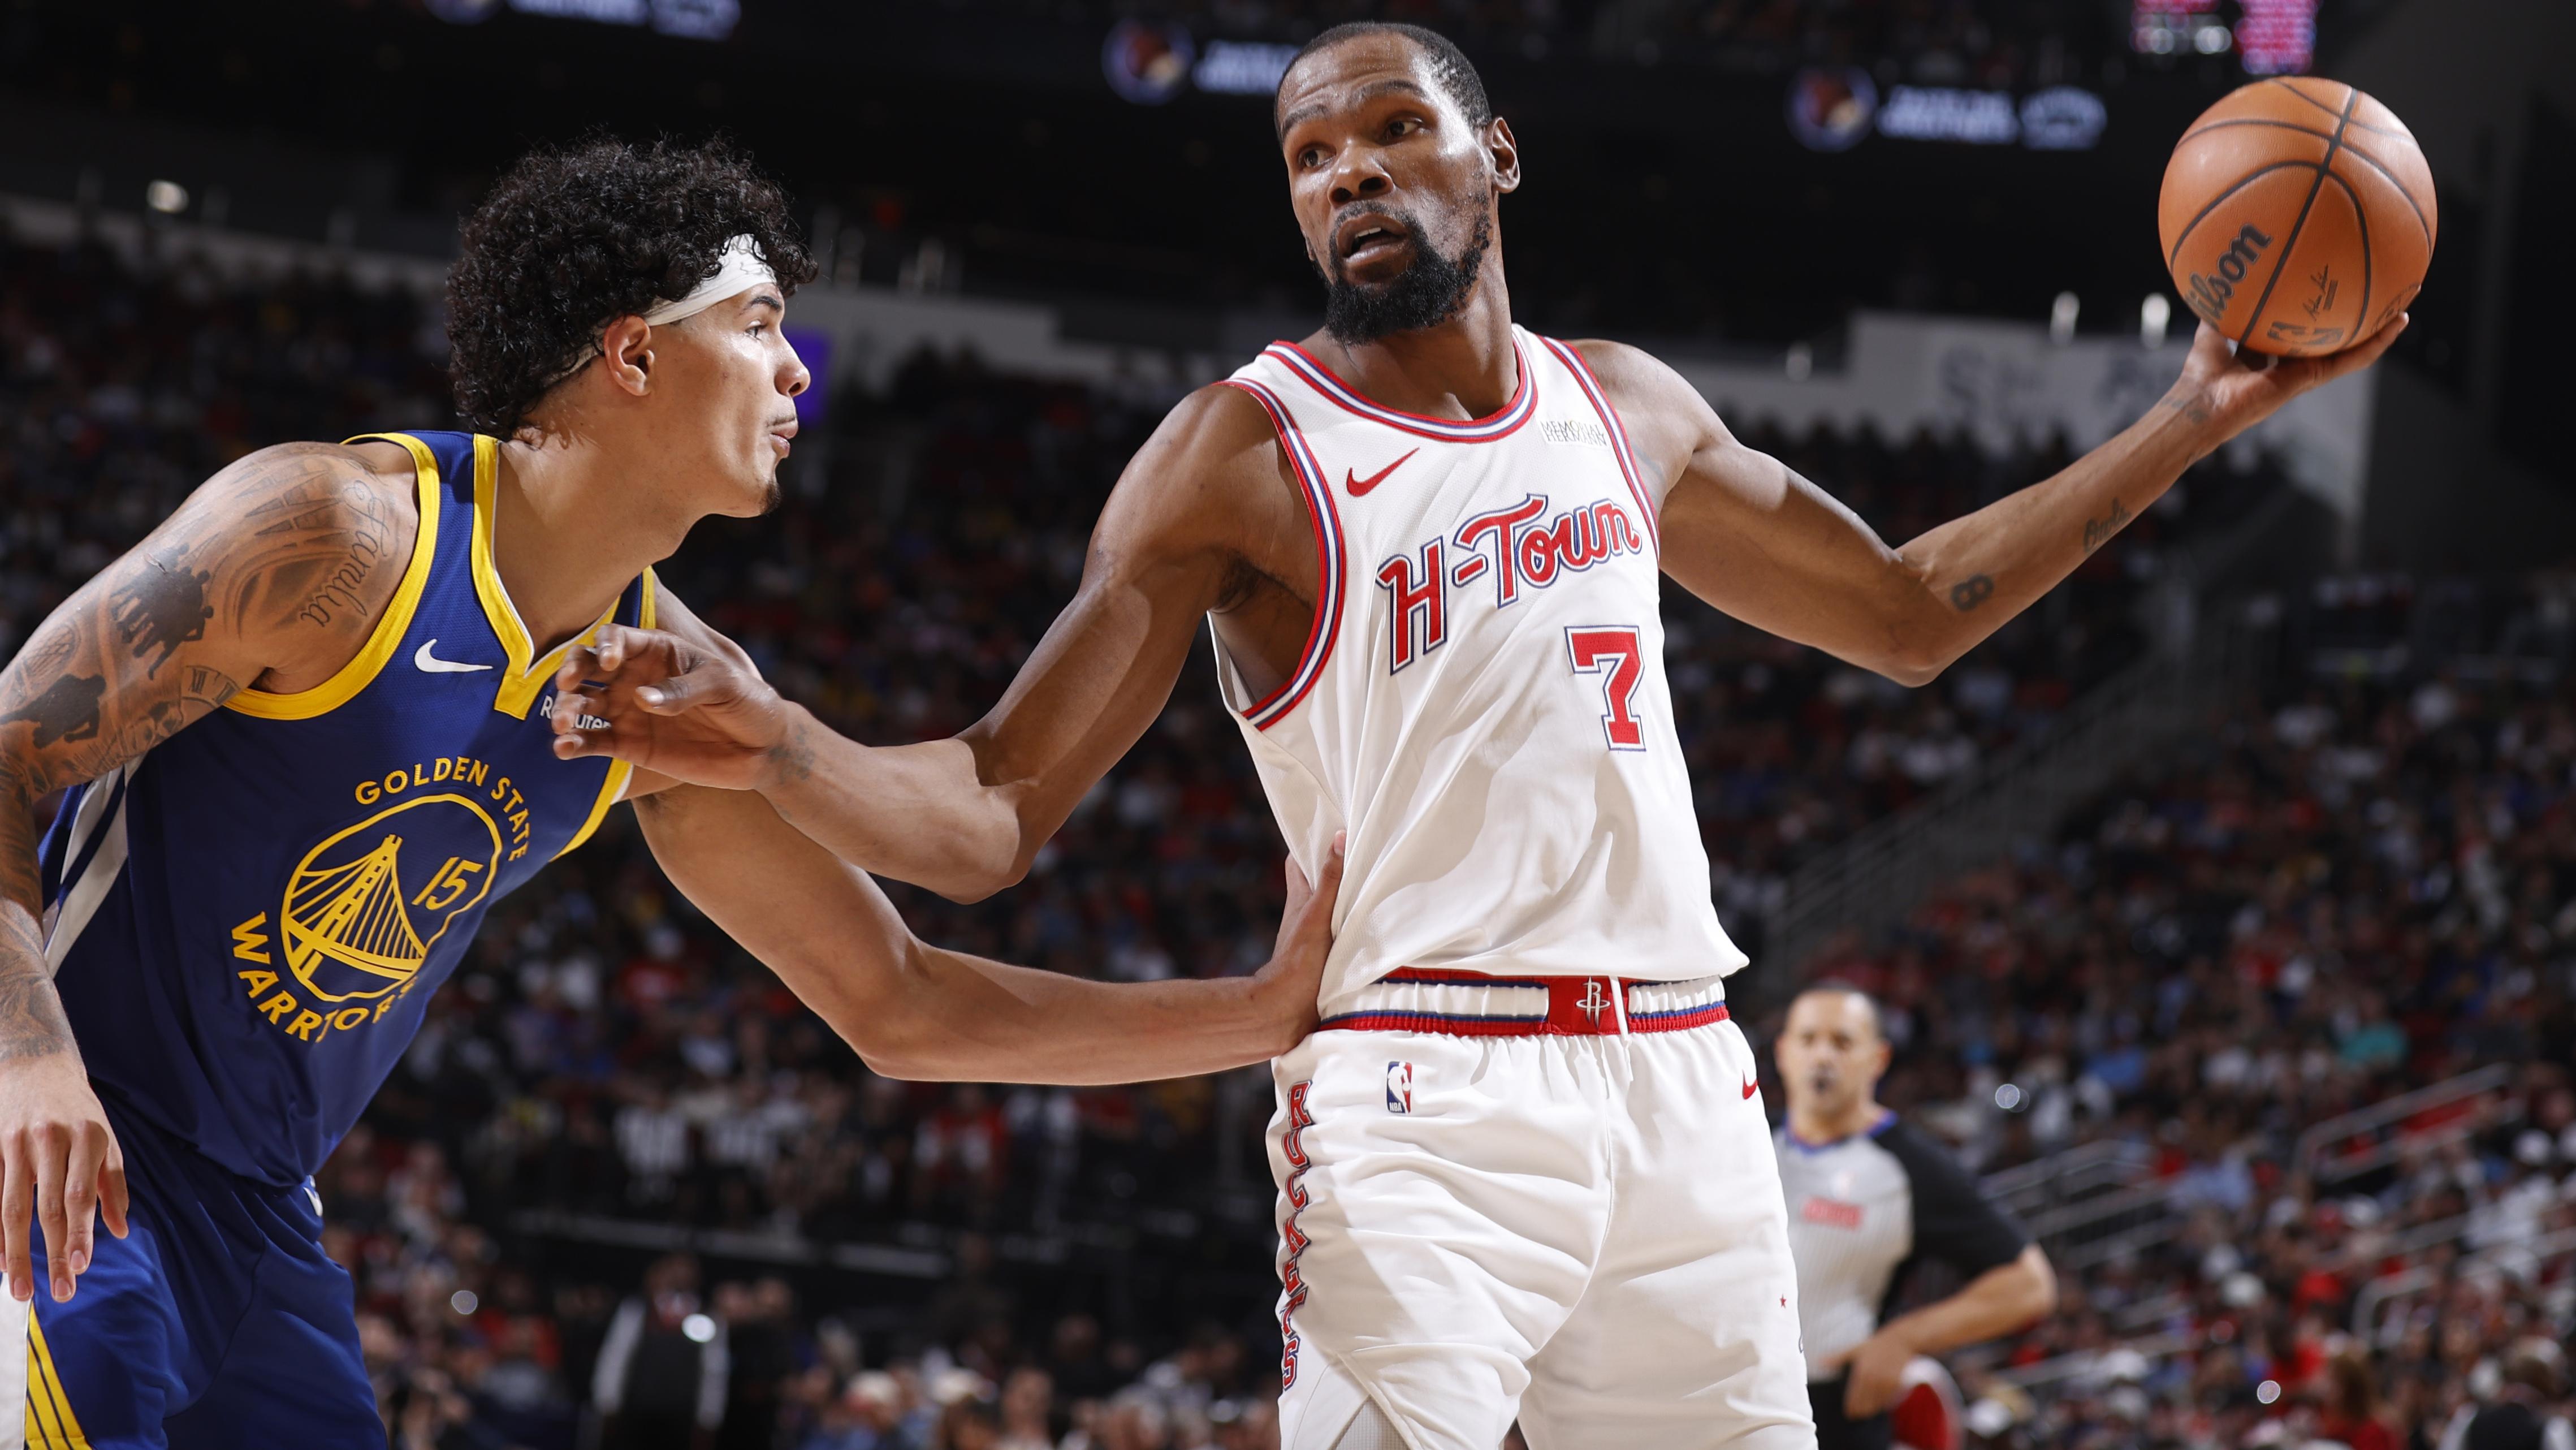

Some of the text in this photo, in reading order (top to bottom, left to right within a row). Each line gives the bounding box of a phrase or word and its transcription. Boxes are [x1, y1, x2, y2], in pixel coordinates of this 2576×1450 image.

[1540, 420, 1602, 436] MEMORIAL
[1544, 429, 1607, 446] HERMANN
[300, 479, 392, 628] Familia
[1375, 492, 1643, 676] H-Town
[539, 694, 612, 730] Ruten
[1564, 625, 1646, 752] 7
[354, 756, 530, 862] GOLDEN STATE
[412, 856, 484, 911] 15
[1389, 1101, 1403, 1112] NBA
